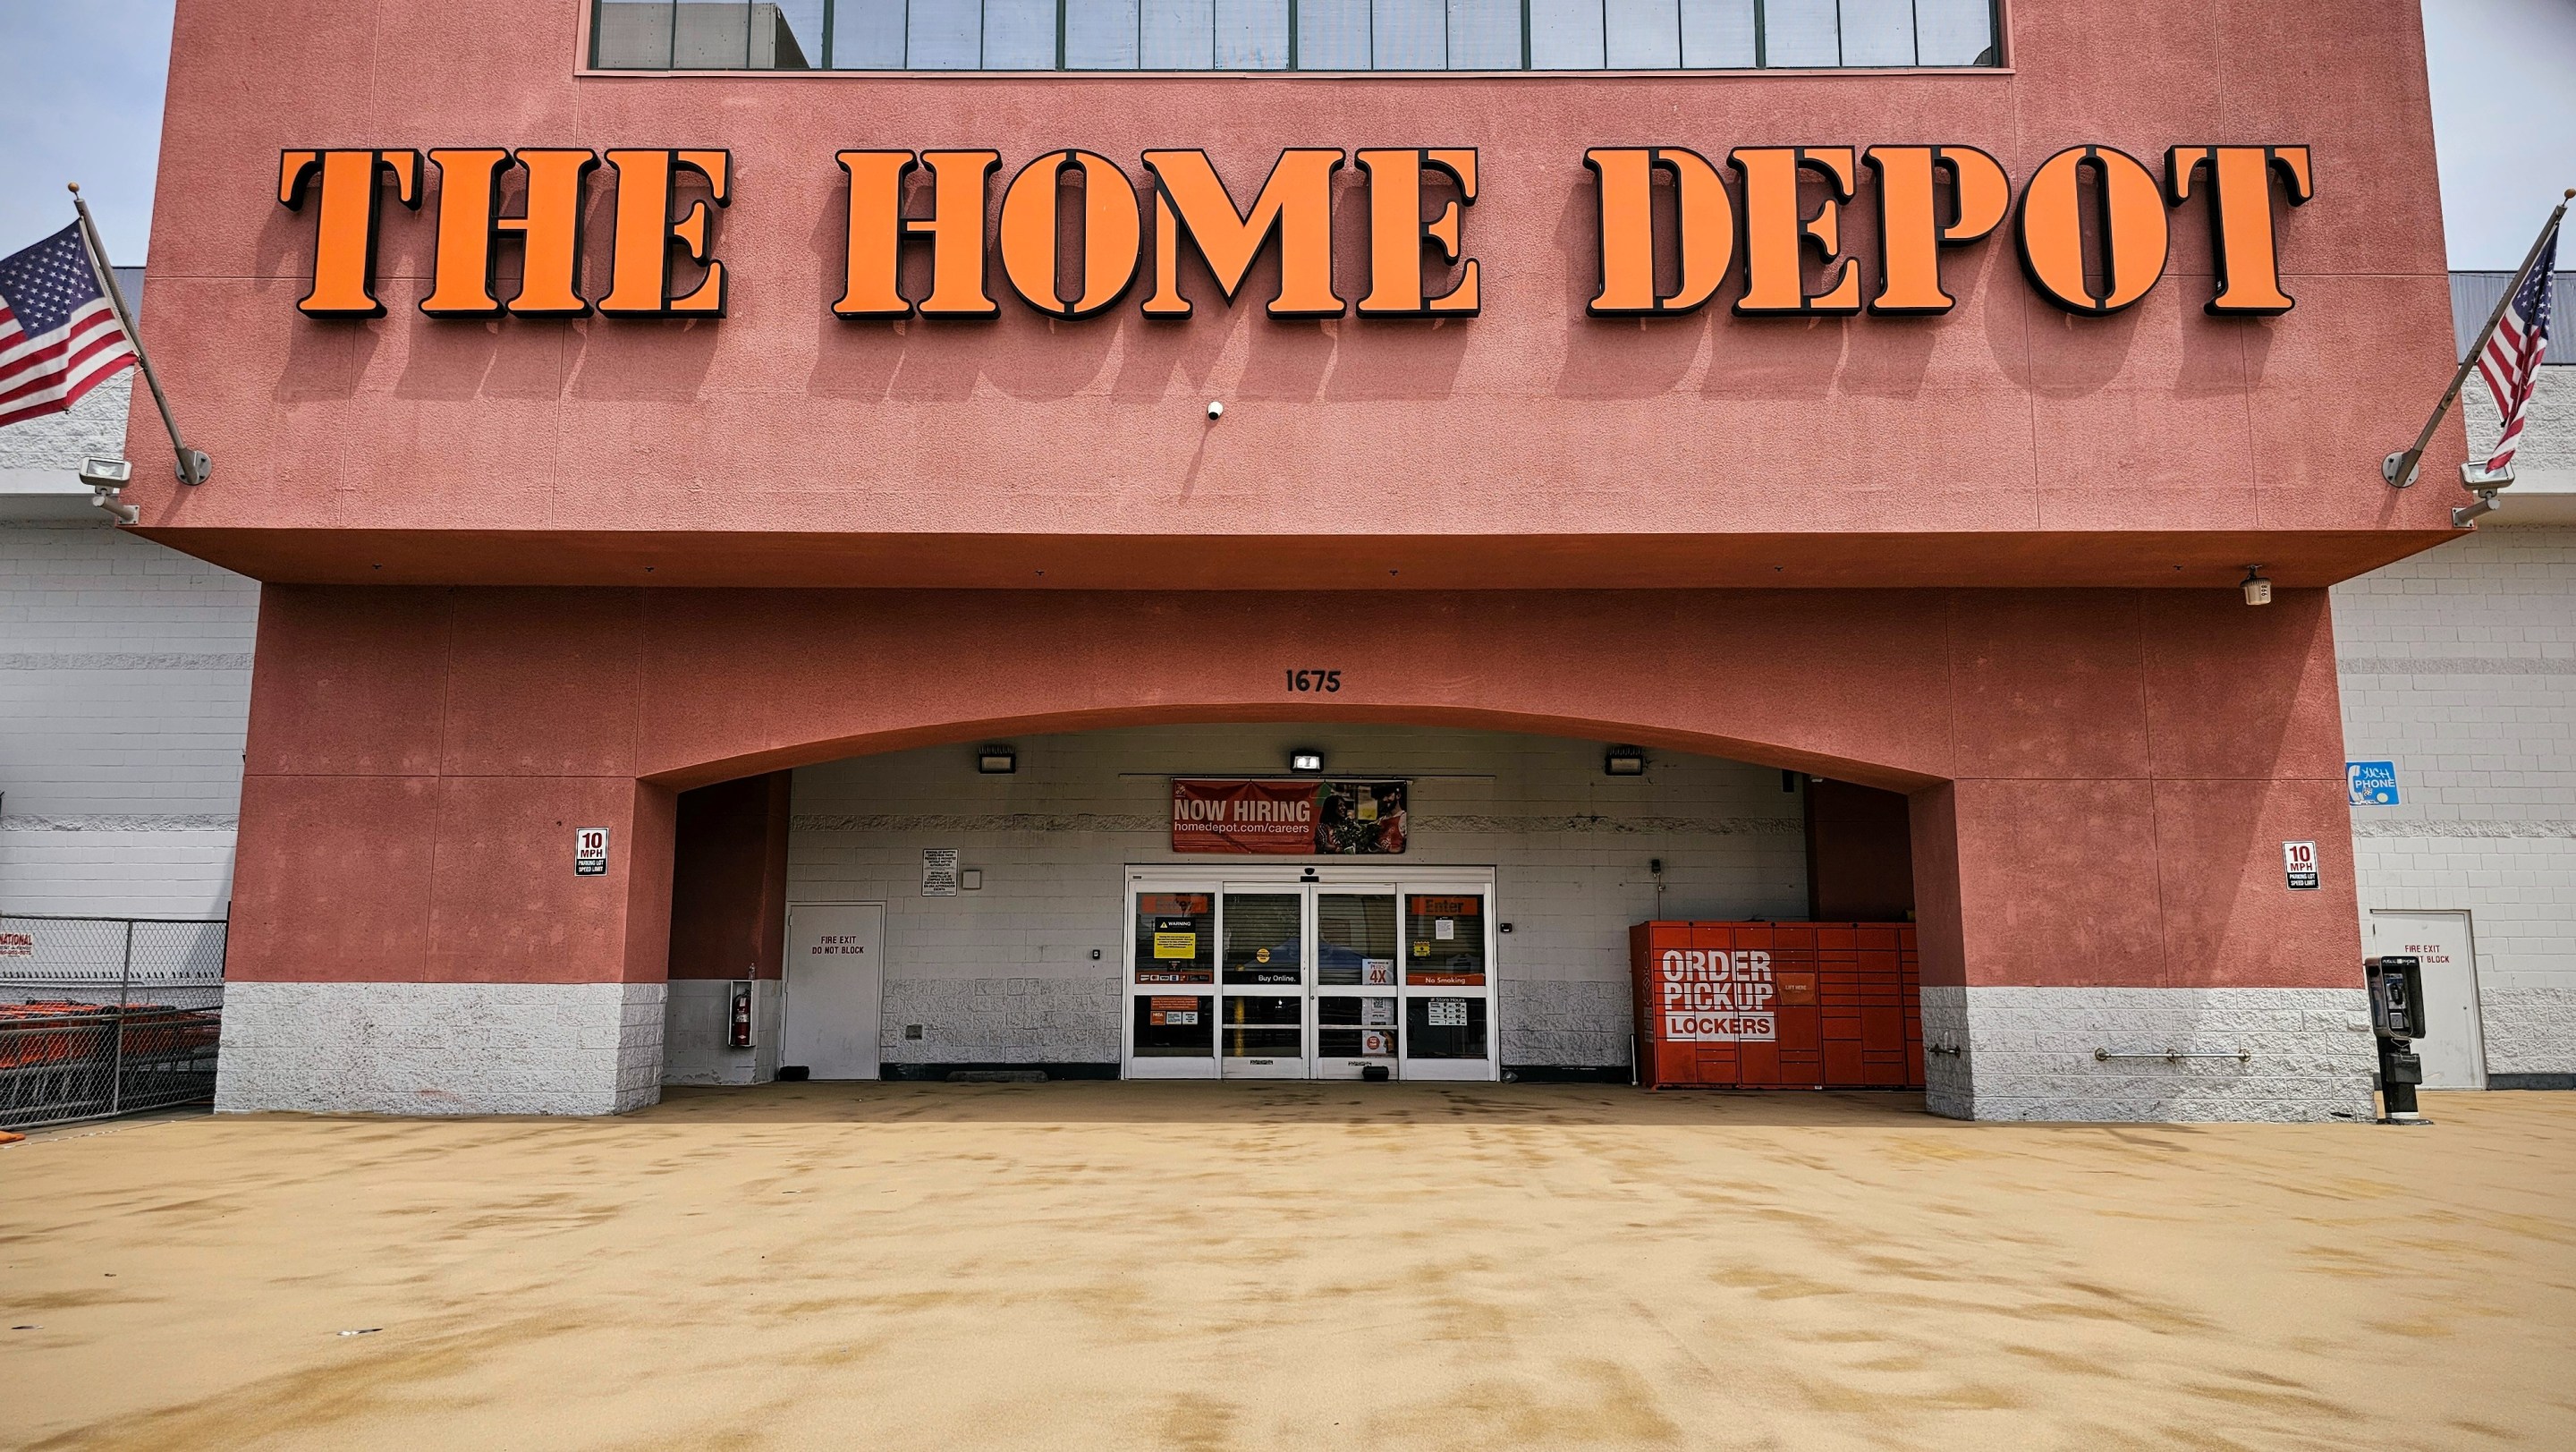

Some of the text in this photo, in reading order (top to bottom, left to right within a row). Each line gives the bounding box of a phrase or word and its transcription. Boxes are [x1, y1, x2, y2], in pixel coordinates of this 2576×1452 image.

[277, 144, 2315, 322] THE HOME DEPOT
[1286, 669, 1342, 692] 1675
[2355, 779, 2395, 788] PHONE
[1174, 799, 1310, 822] NOW HIRING
[1174, 822, 1309, 833] homedepot.com/careers
[582, 832, 603, 848] 10
[580, 849, 603, 858] MPH
[2289, 845, 2310, 862] 10
[2290, 862, 2312, 871] MPH
[1425, 899, 1464, 913] Enter
[821, 936, 856, 944] FIRE EXIT
[2405, 945, 2440, 953] FIRE EXIT
[1662, 950, 1773, 981] ORDER
[1369, 970, 1386, 983] 4X
[1664, 982, 1774, 1011] PICKUP
[1671, 1018, 1771, 1034] LOCKERS
